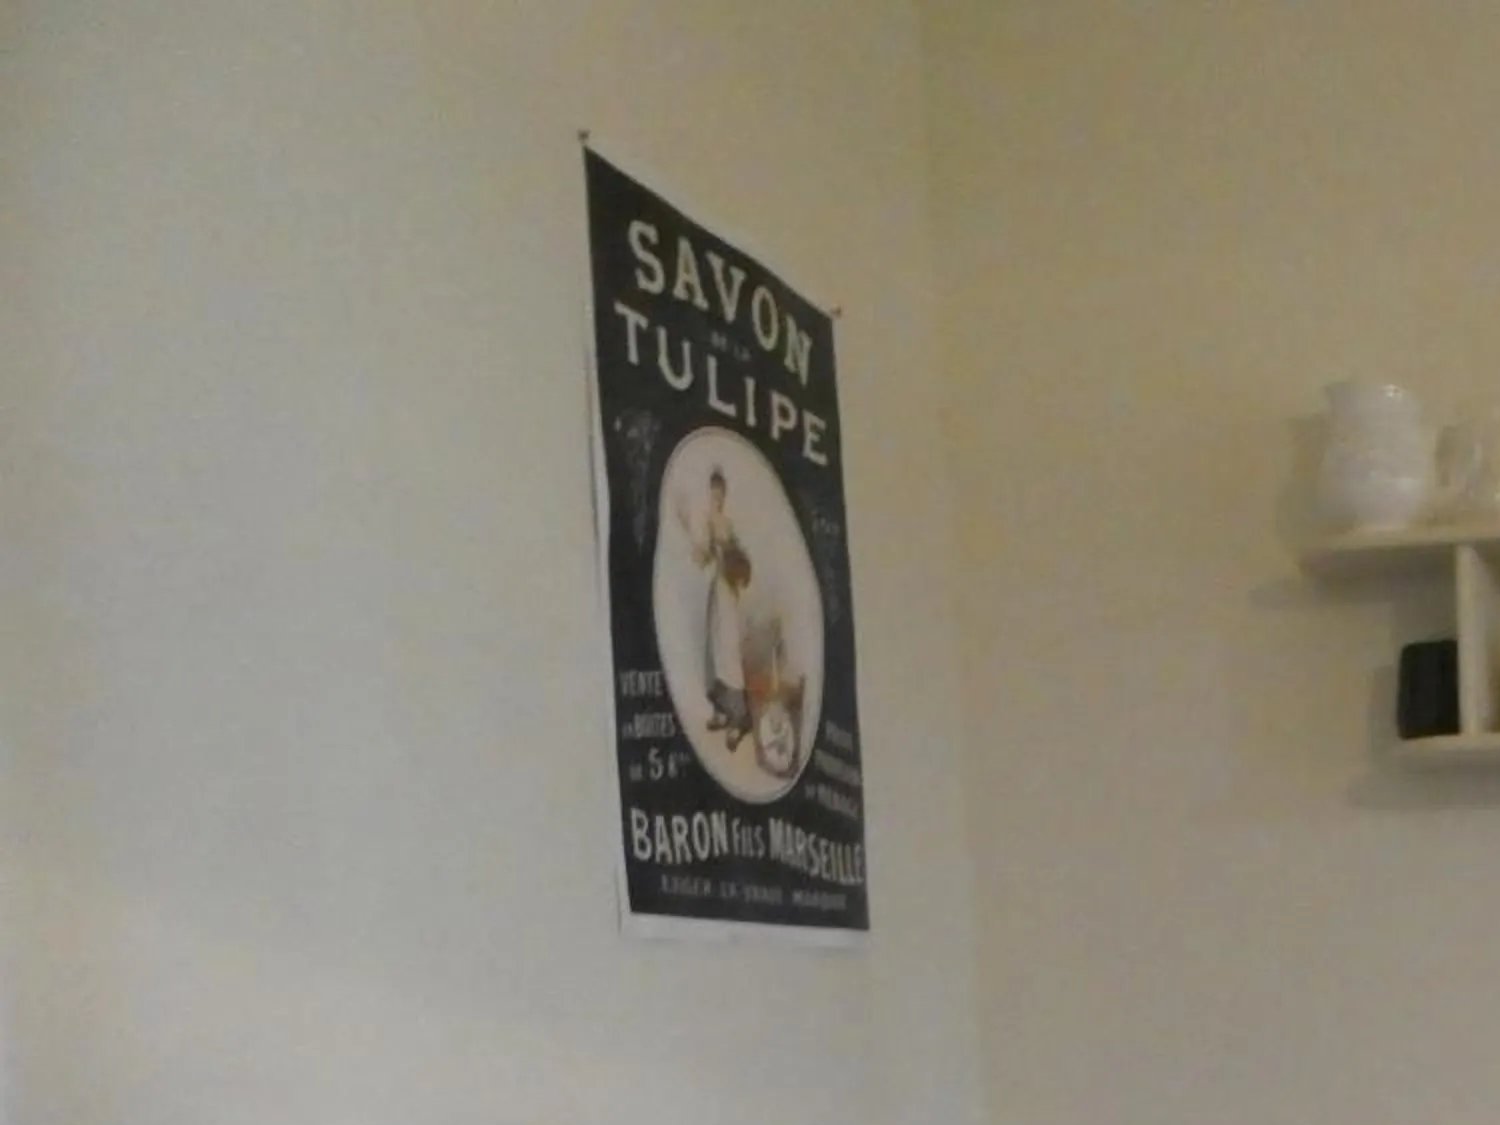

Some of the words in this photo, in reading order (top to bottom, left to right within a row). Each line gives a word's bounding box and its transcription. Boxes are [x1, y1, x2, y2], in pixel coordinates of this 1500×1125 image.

[613, 301, 828, 467] TULIPE
[628, 219, 813, 387] SAVON
[631, 807, 729, 865] BARON
[768, 816, 865, 885] MARSEILLE
